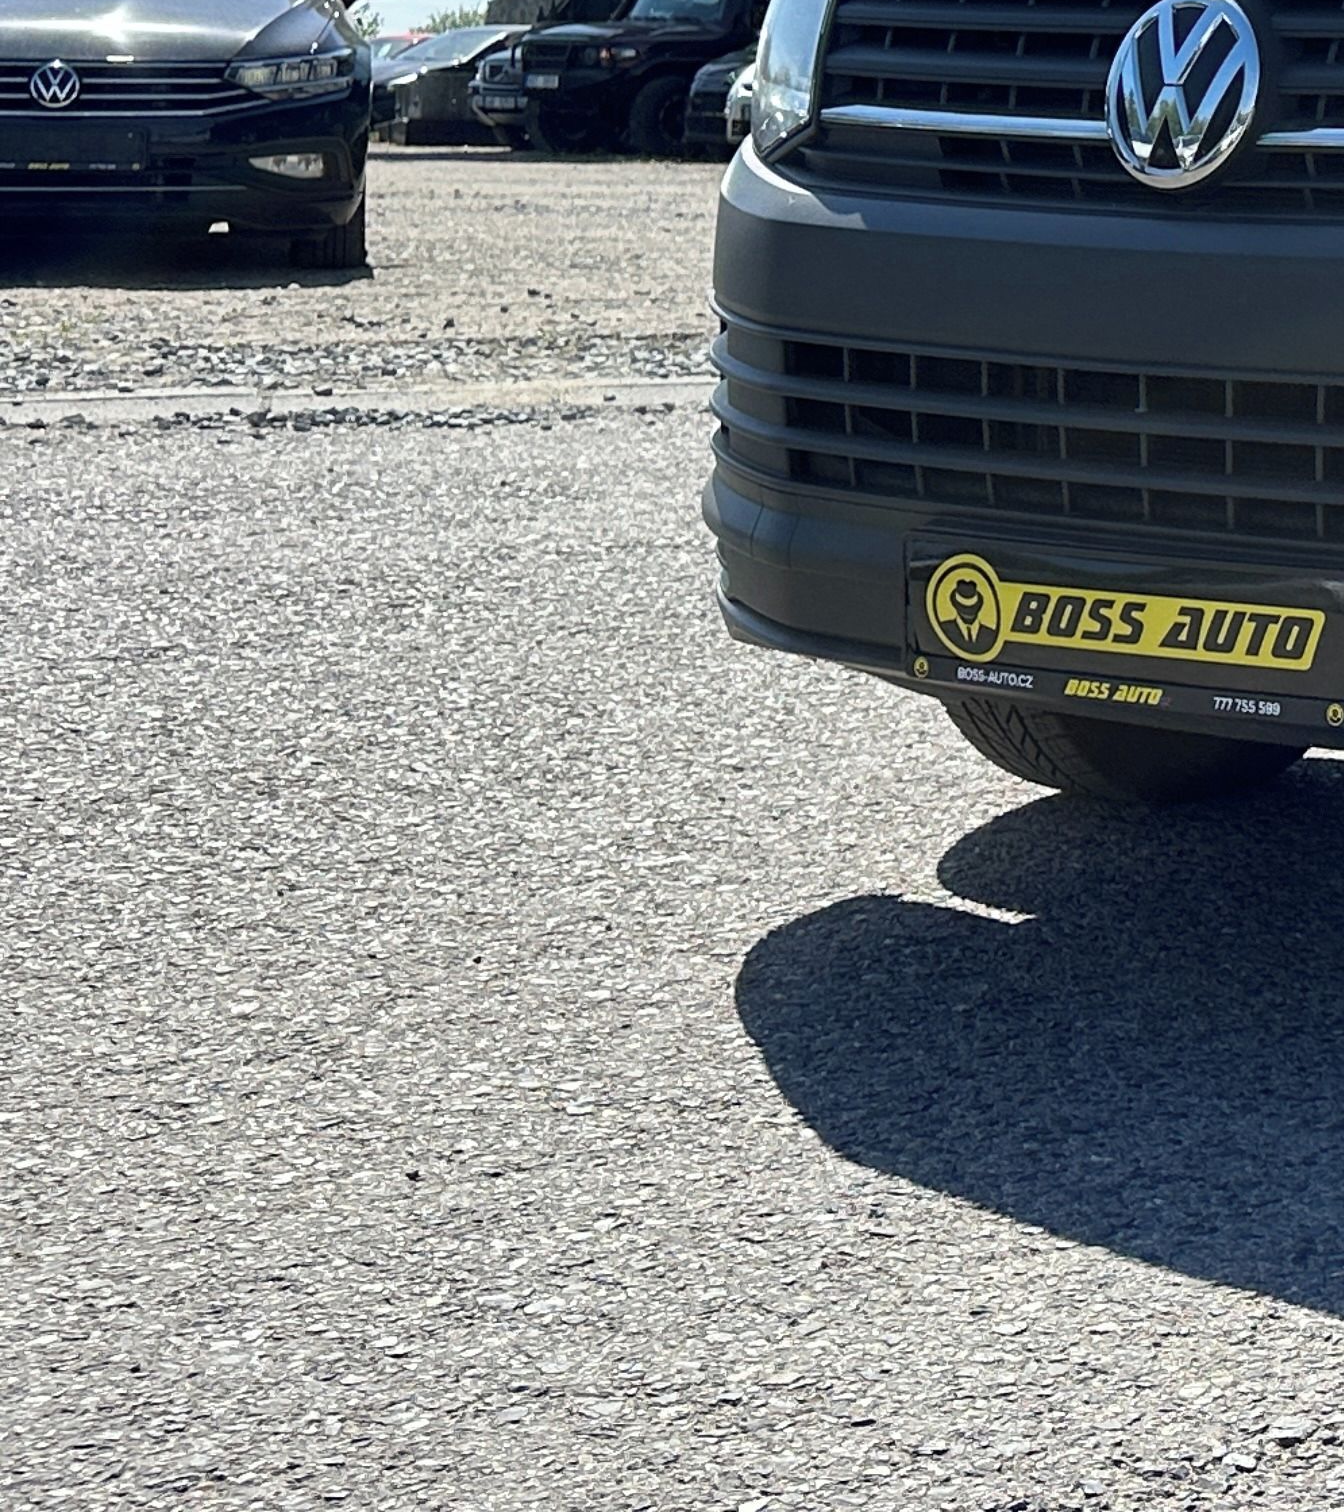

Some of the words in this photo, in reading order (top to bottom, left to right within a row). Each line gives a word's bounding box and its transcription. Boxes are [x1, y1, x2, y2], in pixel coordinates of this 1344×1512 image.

[1010, 591, 1147, 644] BOSS
[1158, 606, 1315, 660] AUTO
[957, 666, 1034, 689] BOSS-AUTO.CZ
[1064, 679, 1110, 700] BOSS
[1112, 685, 1163, 705] AUTO
[1213, 696, 1233, 711] 777
